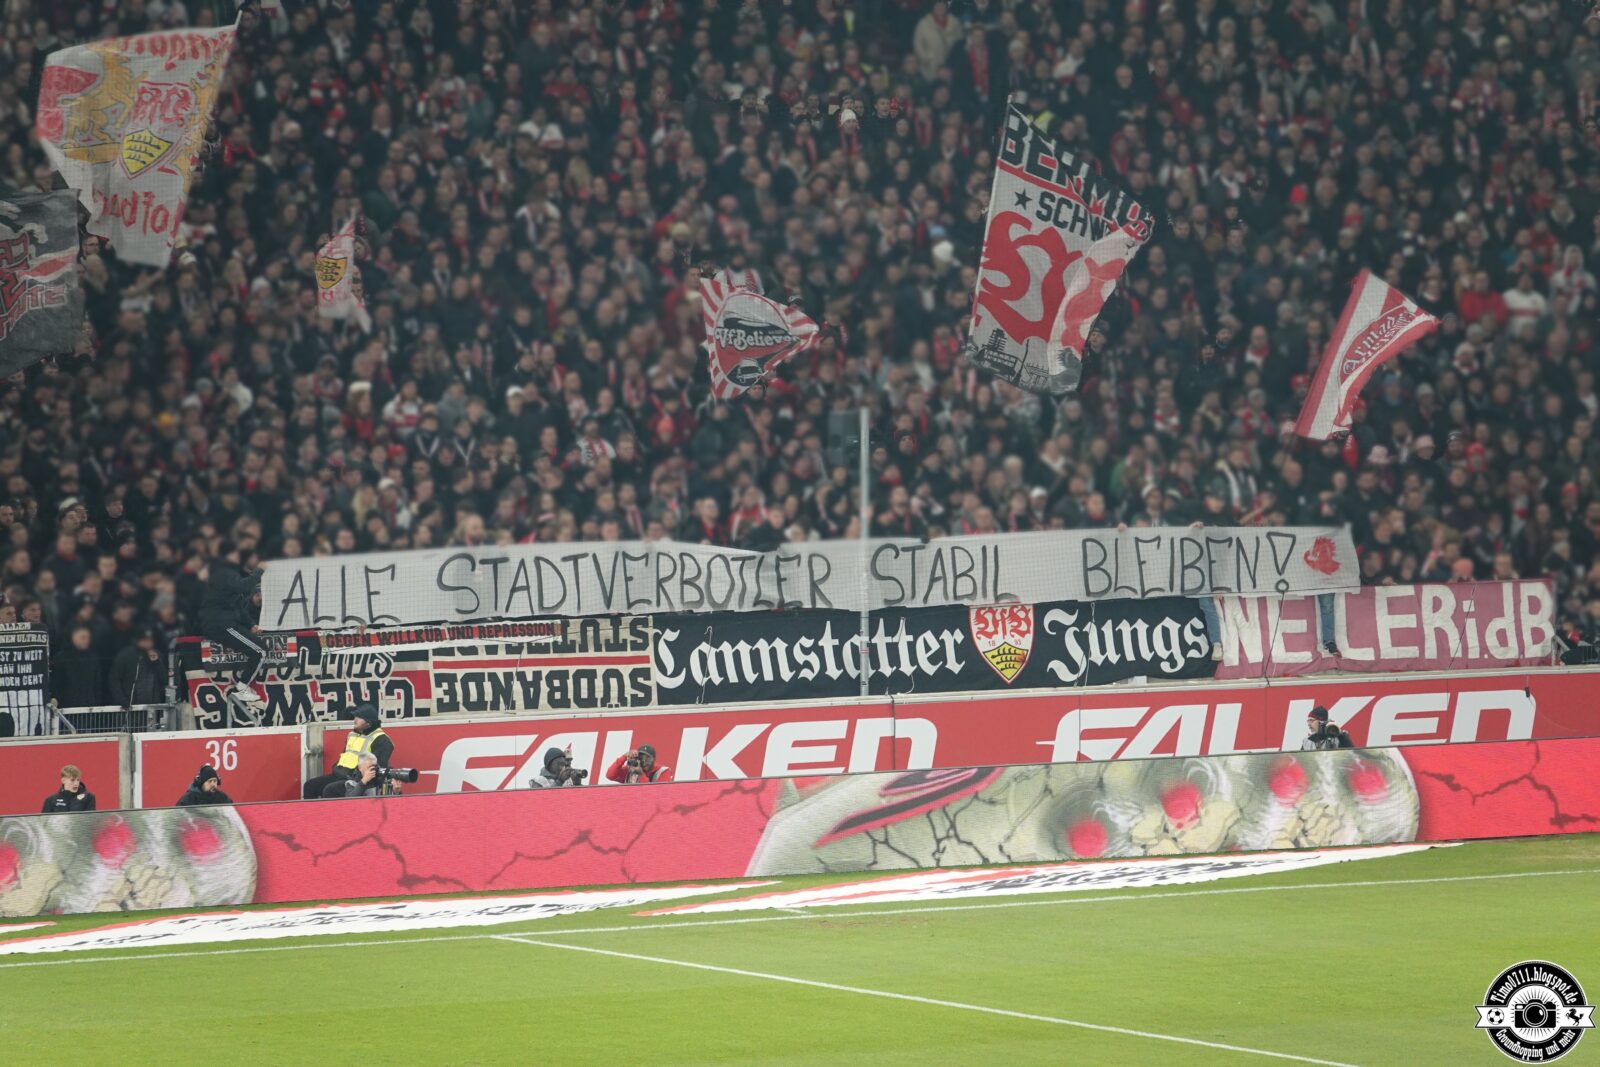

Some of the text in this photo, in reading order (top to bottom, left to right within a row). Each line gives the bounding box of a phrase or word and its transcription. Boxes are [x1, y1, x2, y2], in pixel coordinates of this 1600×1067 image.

[277, 531, 1297, 627] ALLE STADTVERBOTLER STABIL BLEIBEN!
[12, 651, 22, 662] ZU
[24, 650, 43, 661] WEIT
[17, 633, 47, 643] ULTRAS
[326, 632, 372, 648] GEGEN
[376, 624, 445, 646] WILLKÜR
[447, 626, 474, 641] UND
[478, 622, 556, 639] REPRESSION
[653, 617, 966, 690] Cannstatter
[1043, 608, 1210, 683] Jungs
[22, 674, 44, 686] GEHT
[433, 667, 653, 713] SÜDBANDE
[262, 679, 415, 728] CREW
[1037, 689, 1536, 763] FALKEN
[205, 739, 238, 771] 36
[420, 717, 938, 793] FALKEN
